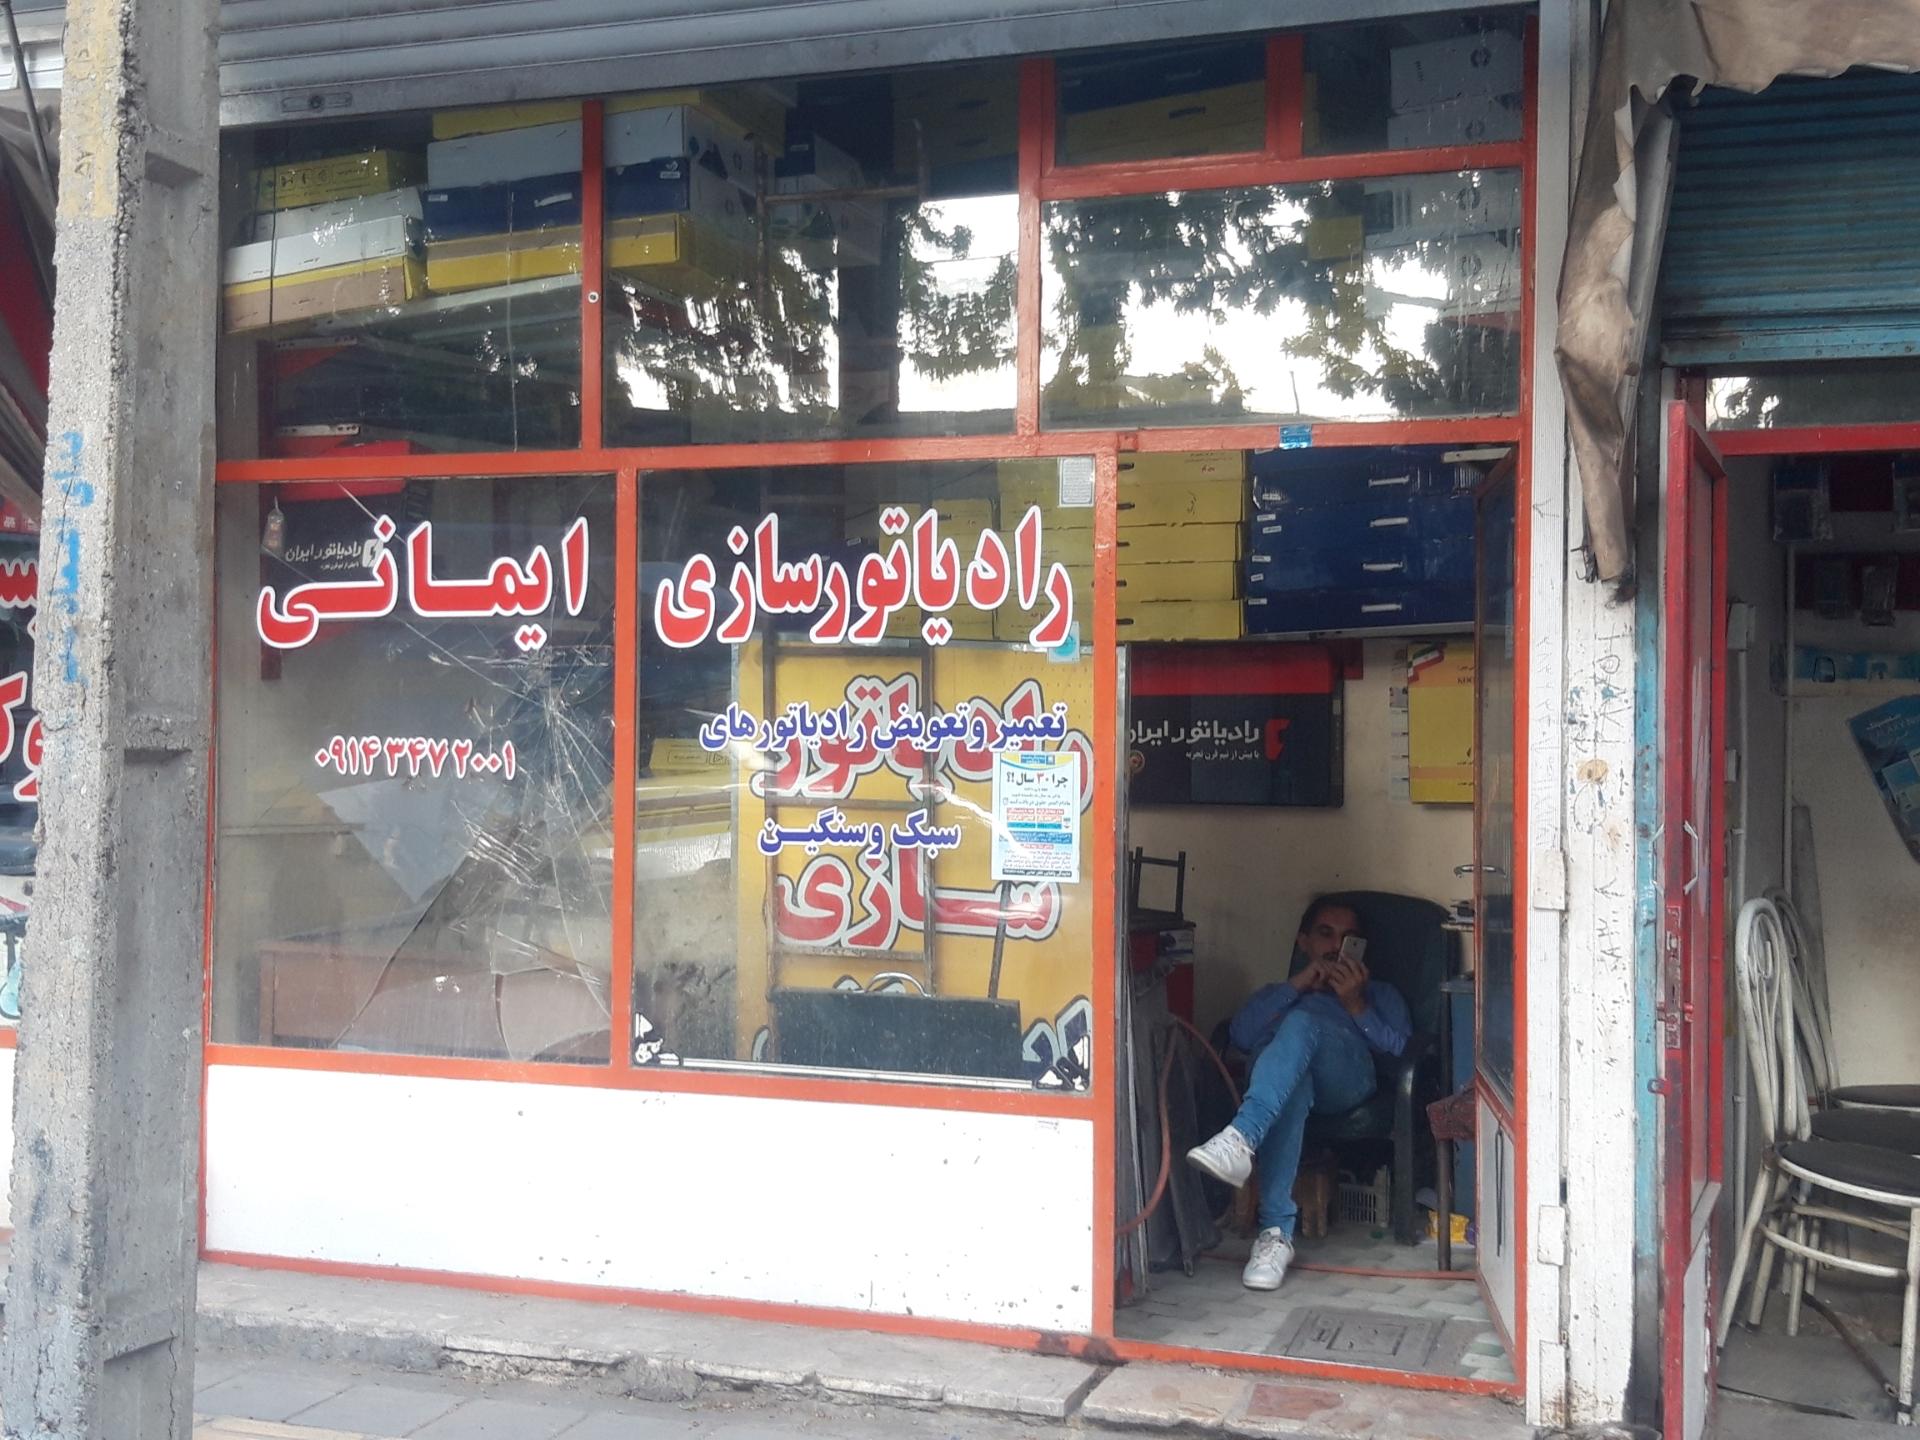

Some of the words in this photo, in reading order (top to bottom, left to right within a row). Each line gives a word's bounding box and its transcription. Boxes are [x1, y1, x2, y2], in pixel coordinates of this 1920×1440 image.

[285, 544, 314, 562] ایران
[314, 540, 362, 560] رادیاتور
[257, 514, 590, 651] ایمانی
[991, 701, 1069, 752] تعمیر
[1171, 720, 1260, 745] رادیاتور
[1037, 772, 1049, 784] ۳۰
[891, 807, 961, 859] سبک
